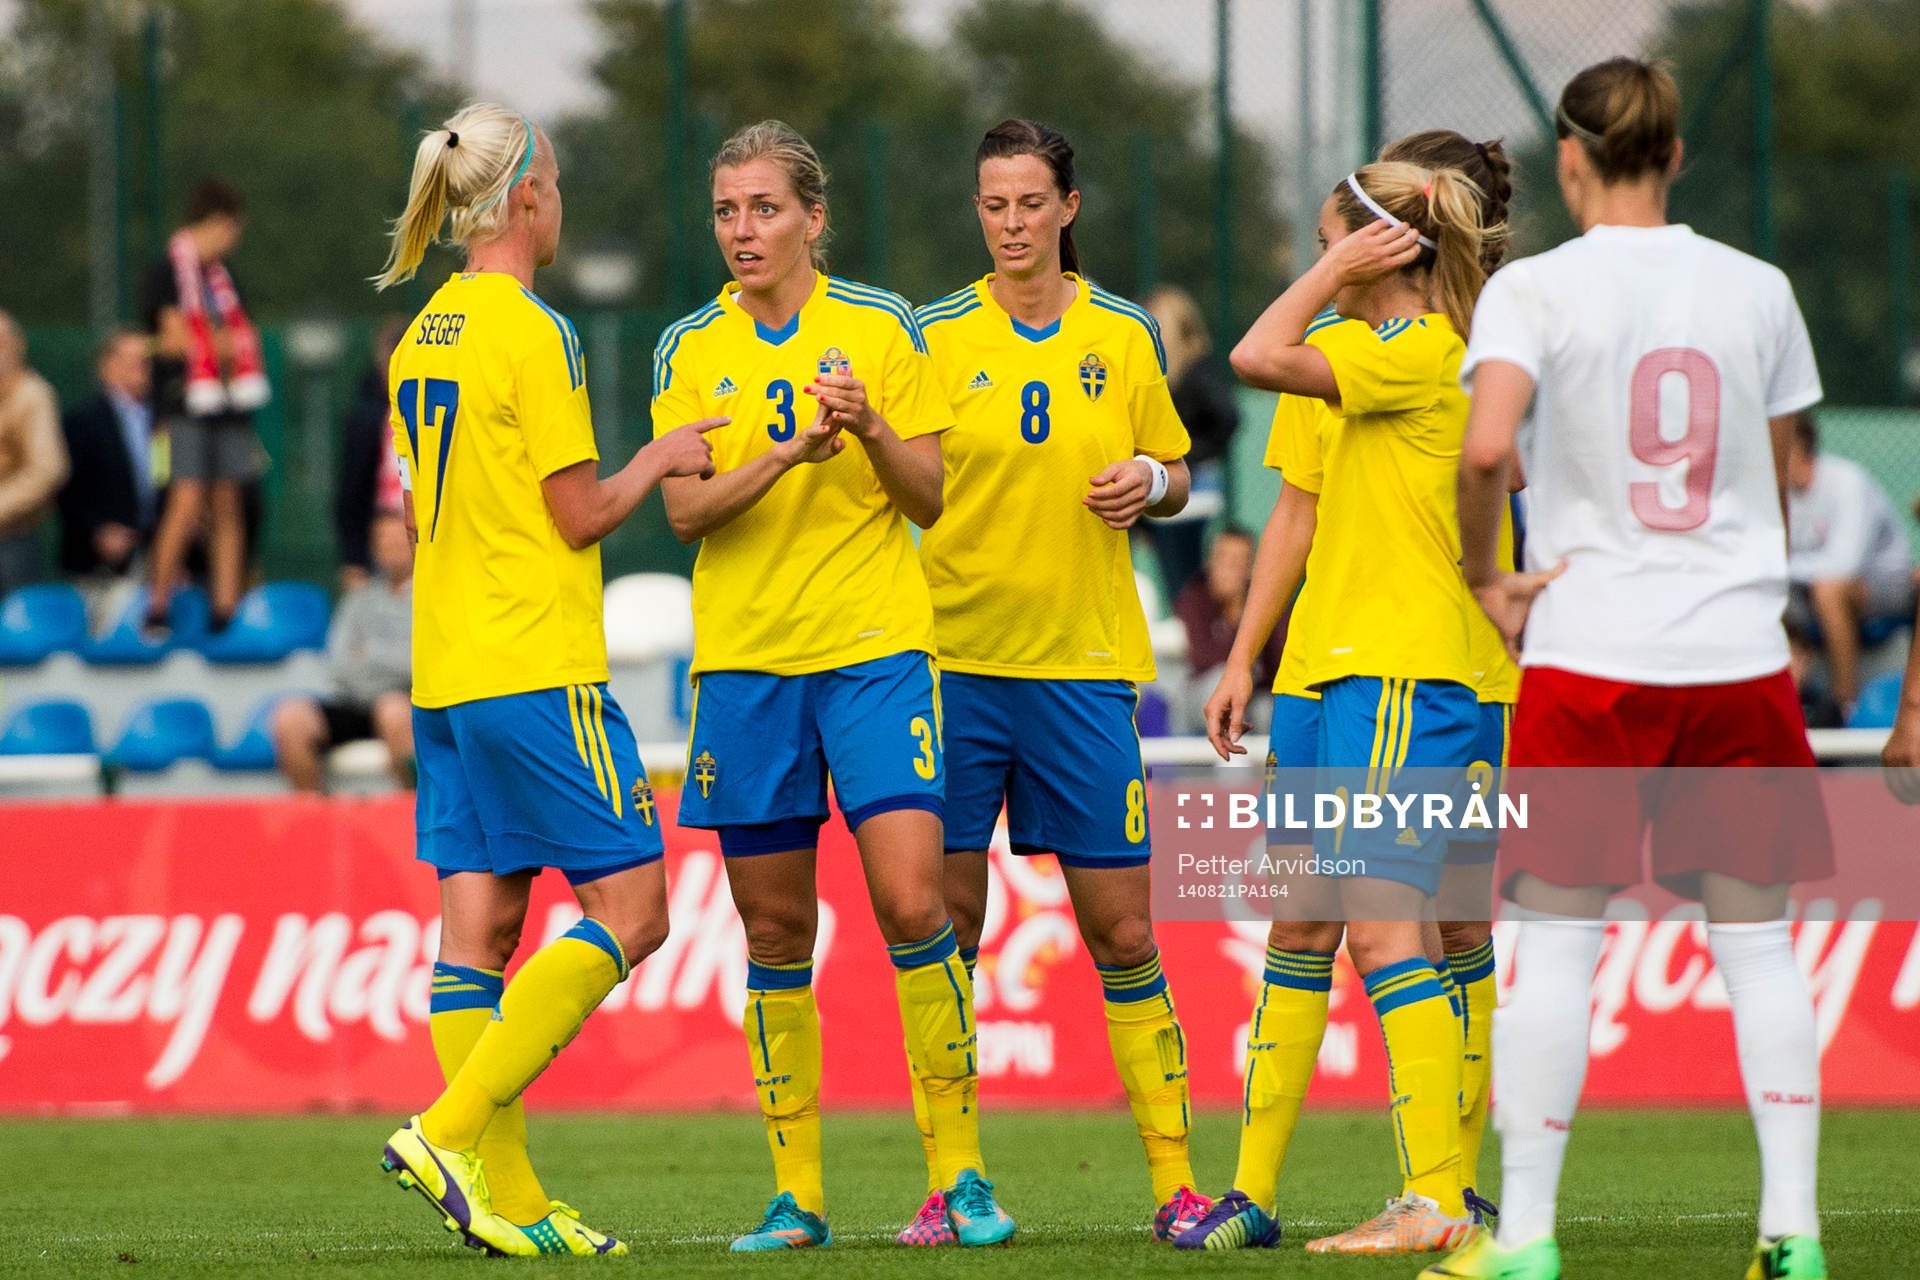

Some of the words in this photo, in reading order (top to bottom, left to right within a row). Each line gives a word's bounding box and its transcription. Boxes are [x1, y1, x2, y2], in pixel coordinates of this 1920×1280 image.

[416, 313, 465, 346] SEGER
[766, 379, 796, 442] 3
[1020, 380, 1050, 444] 8
[1629, 347, 1720, 532] 9
[397, 377, 459, 542] 17
[910, 717, 935, 780] 3
[1125, 779, 1145, 843] 8
